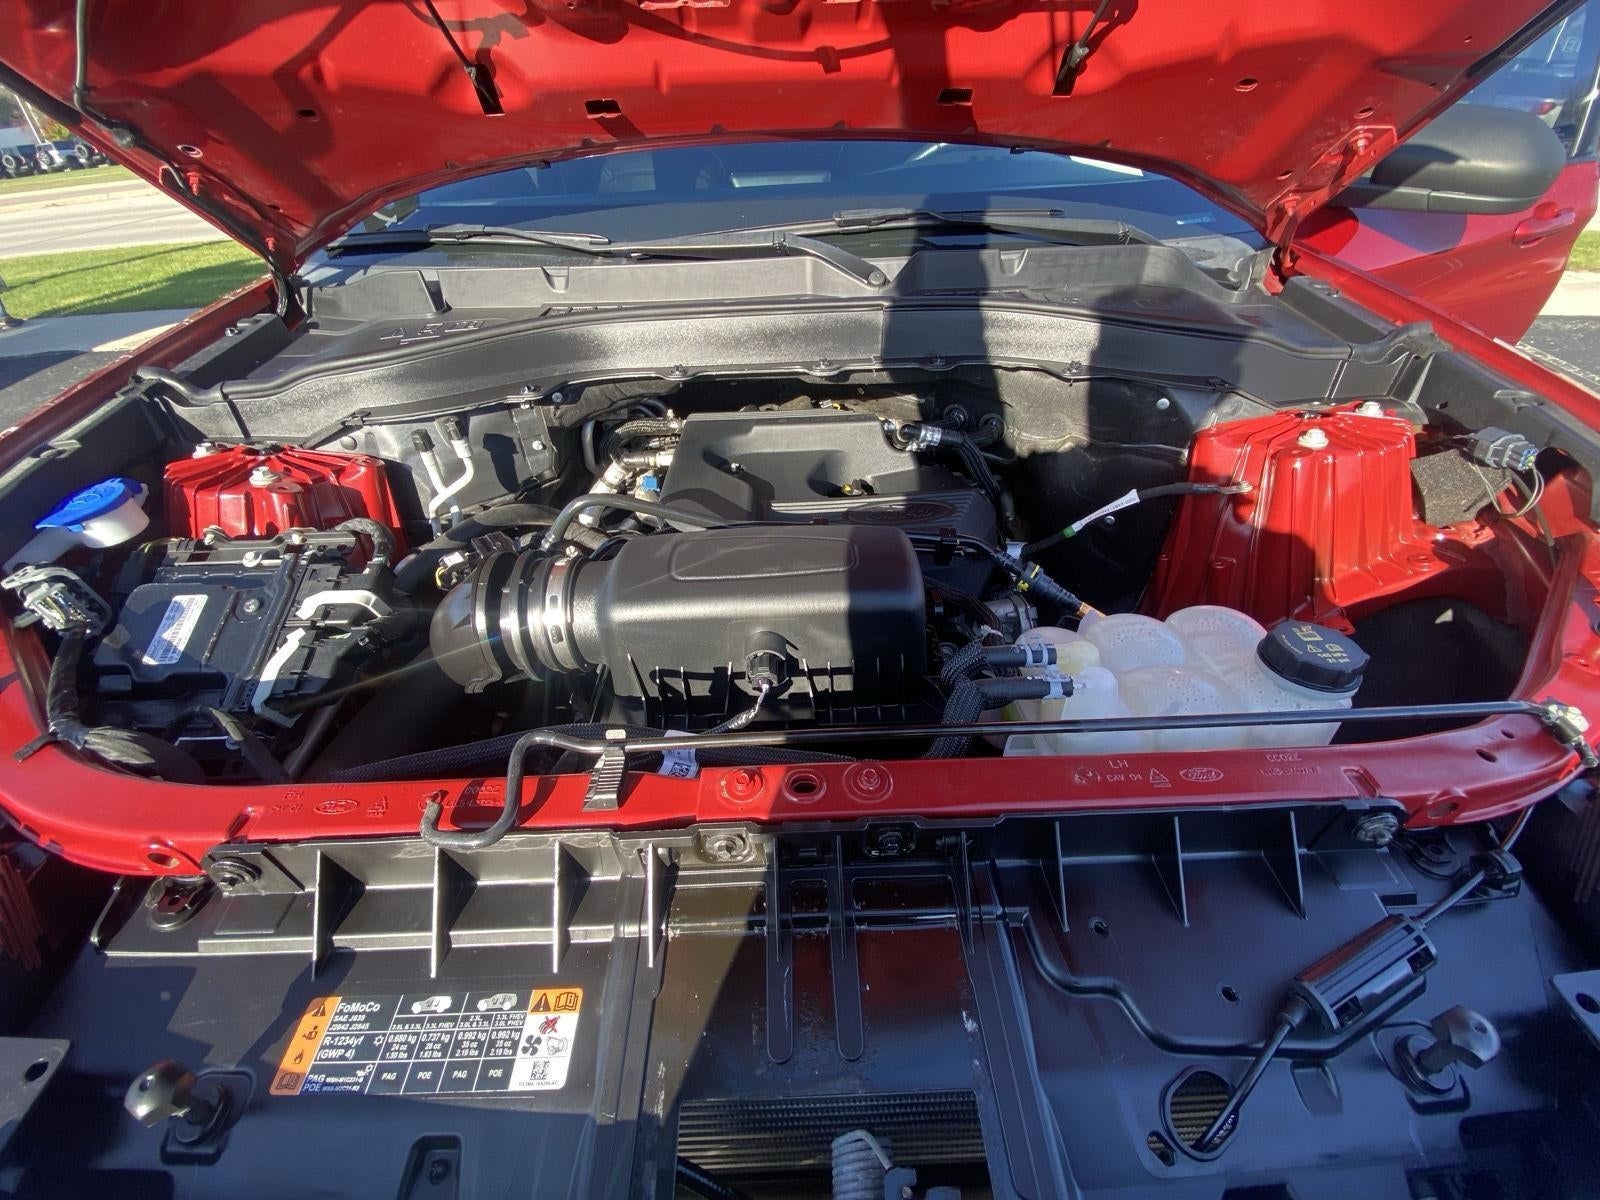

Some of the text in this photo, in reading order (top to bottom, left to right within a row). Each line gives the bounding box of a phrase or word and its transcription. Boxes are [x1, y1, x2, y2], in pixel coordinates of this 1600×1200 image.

[337, 1002, 380, 1012] FoMoCo
[407, 1033, 418, 1044] kg
[421, 1032, 451, 1043] 0.737 kg
[457, 1030, 487, 1041] 0.992 kg
[491, 1029, 521, 1041] 0.992 kg
[323, 1036, 364, 1047] R-1234yf
[461, 1040, 470, 1048] 35
[495, 1039, 504, 1047] 35
[317, 1049, 355, 1060] (GWP 4)
[397, 1051, 408, 1059] lbs
[432, 1050, 442, 1058] lbs
[455, 1049, 470, 1057] 2.19
[489, 1048, 513, 1056] 2.19 lbs
[417, 1071, 432, 1079] POE
[452, 1070, 467, 1078] PAG
[488, 1069, 503, 1077] POE
[306, 1074, 326, 1083] PAG
[302, 1083, 322, 1092] POE
